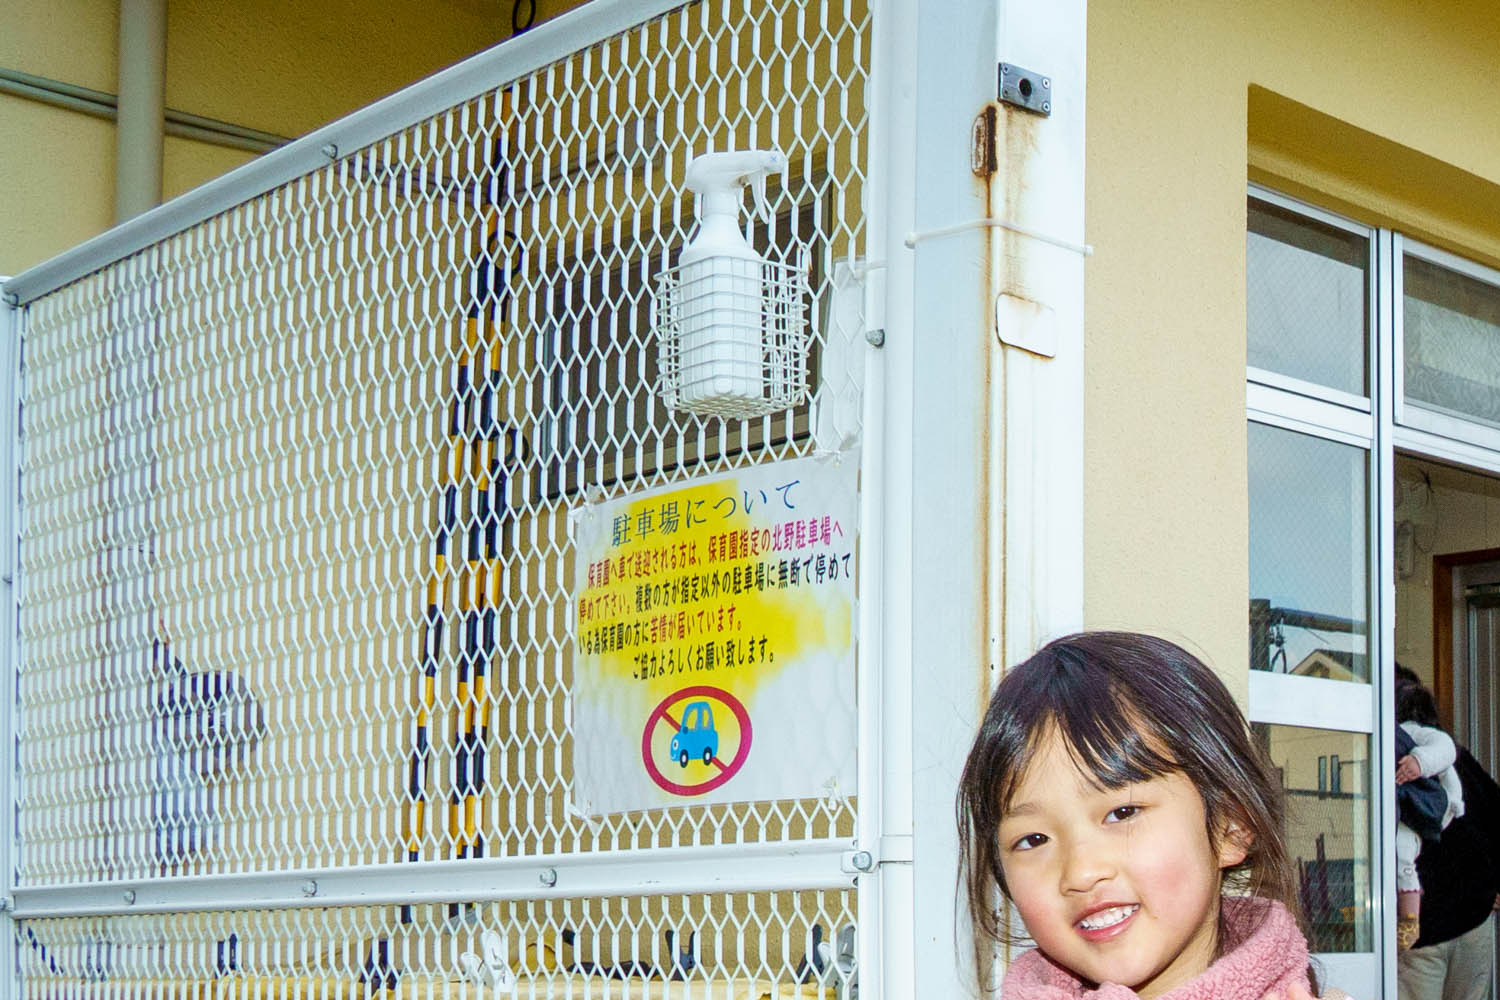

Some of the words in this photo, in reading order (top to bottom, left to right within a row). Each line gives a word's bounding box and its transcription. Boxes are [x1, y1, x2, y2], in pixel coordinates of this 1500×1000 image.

[611, 479, 800, 547] 駐車場について
[588, 515, 844, 590] 保育園へ車で送迎される方は、保育園指定の北野駐車場へ
[633, 634, 774, 681] ご協力よろしくお願い致します。
